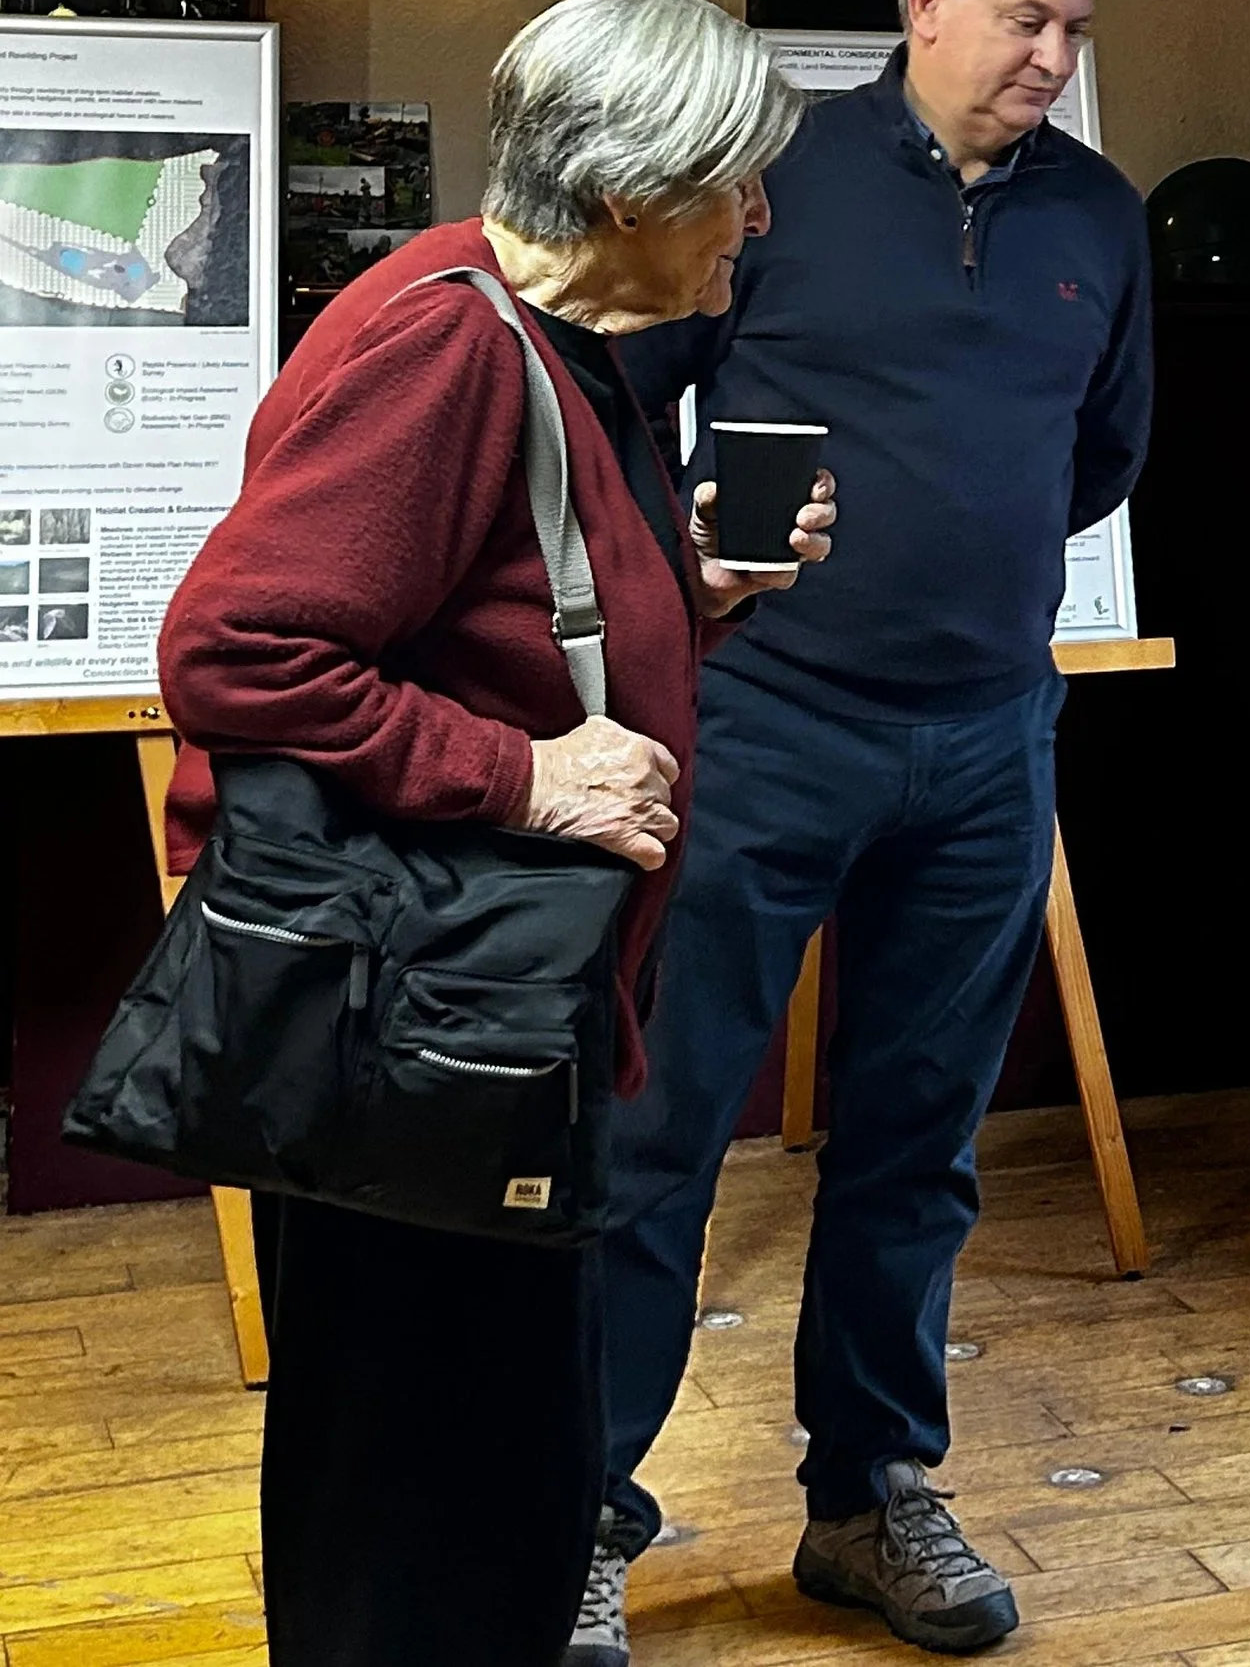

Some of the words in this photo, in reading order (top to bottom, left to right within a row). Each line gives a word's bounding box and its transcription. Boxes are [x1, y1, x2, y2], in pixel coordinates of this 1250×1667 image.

[49, 52, 78, 61] Project
[128, 506, 165, 514] Creation
[12, 658, 32, 667] and
[75, 657, 86, 666] at
[88, 657, 118, 666] every
